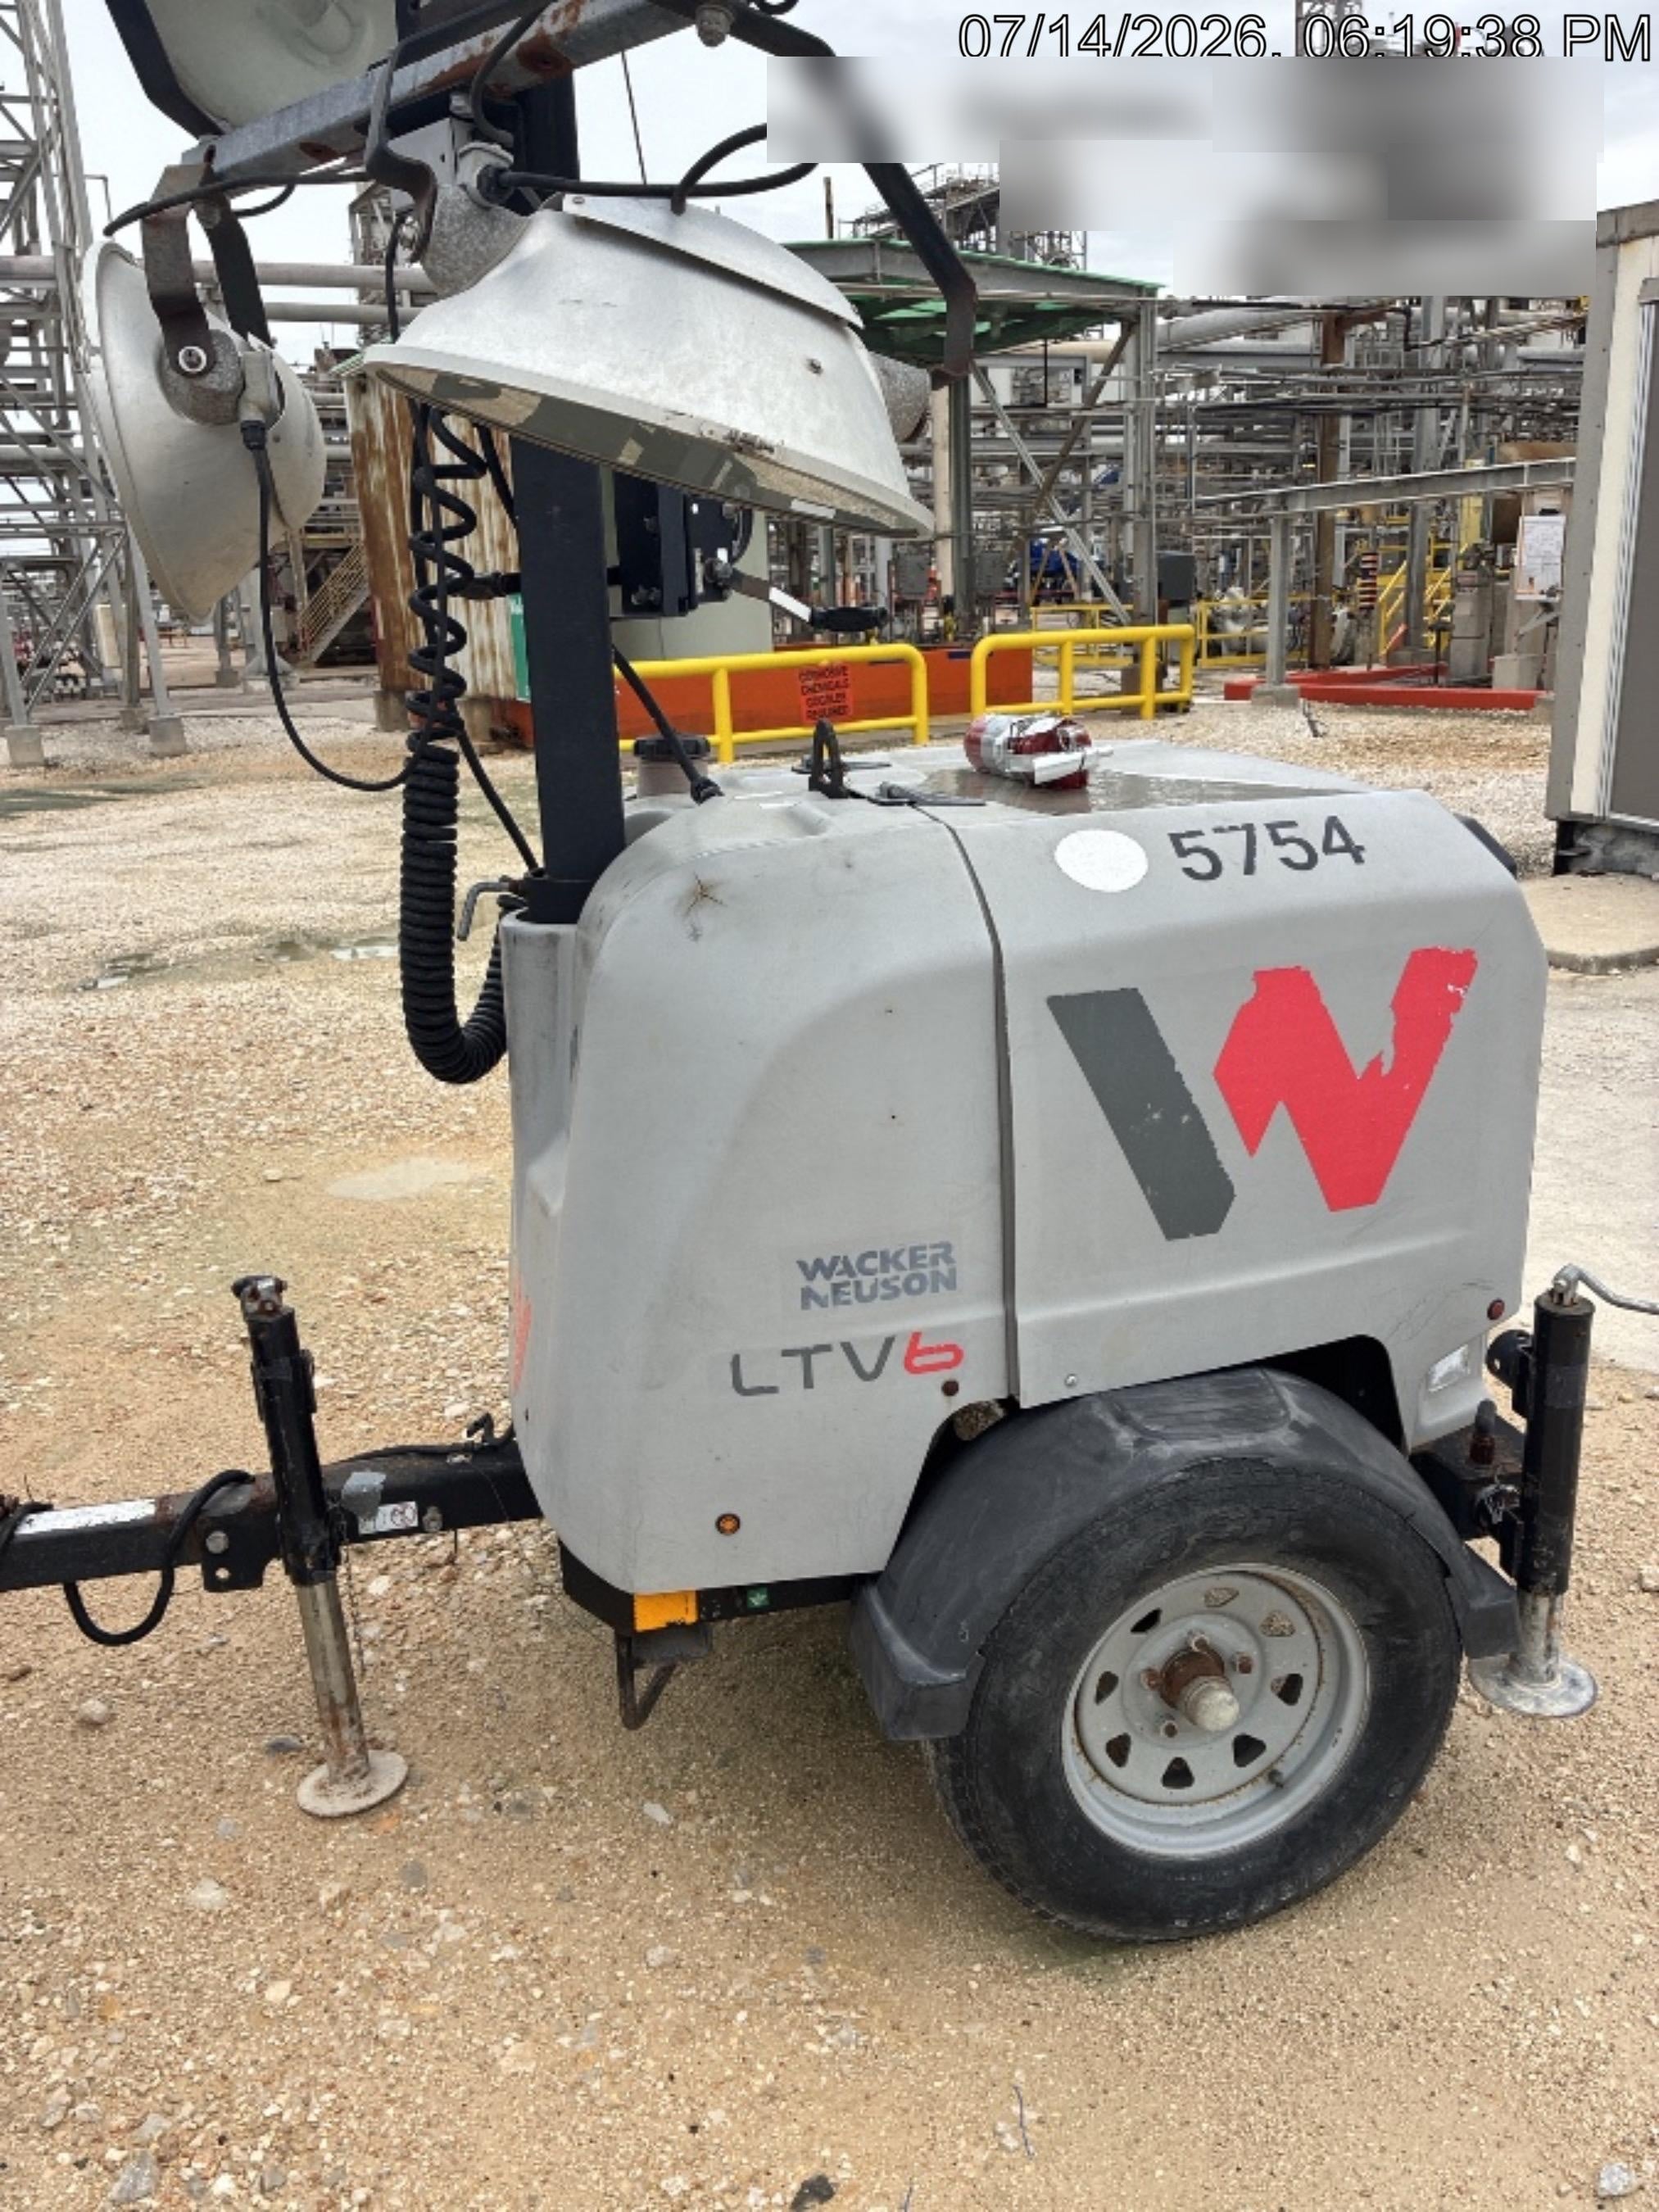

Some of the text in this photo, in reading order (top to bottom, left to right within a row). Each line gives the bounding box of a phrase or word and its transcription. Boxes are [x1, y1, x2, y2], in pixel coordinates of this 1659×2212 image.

[800, 678, 850, 696] CHEMICALS
[1167, 815, 1366, 881] 5754
[796, 1240, 956, 1281] WACKER
[800, 1267, 957, 1310] NEUSON
